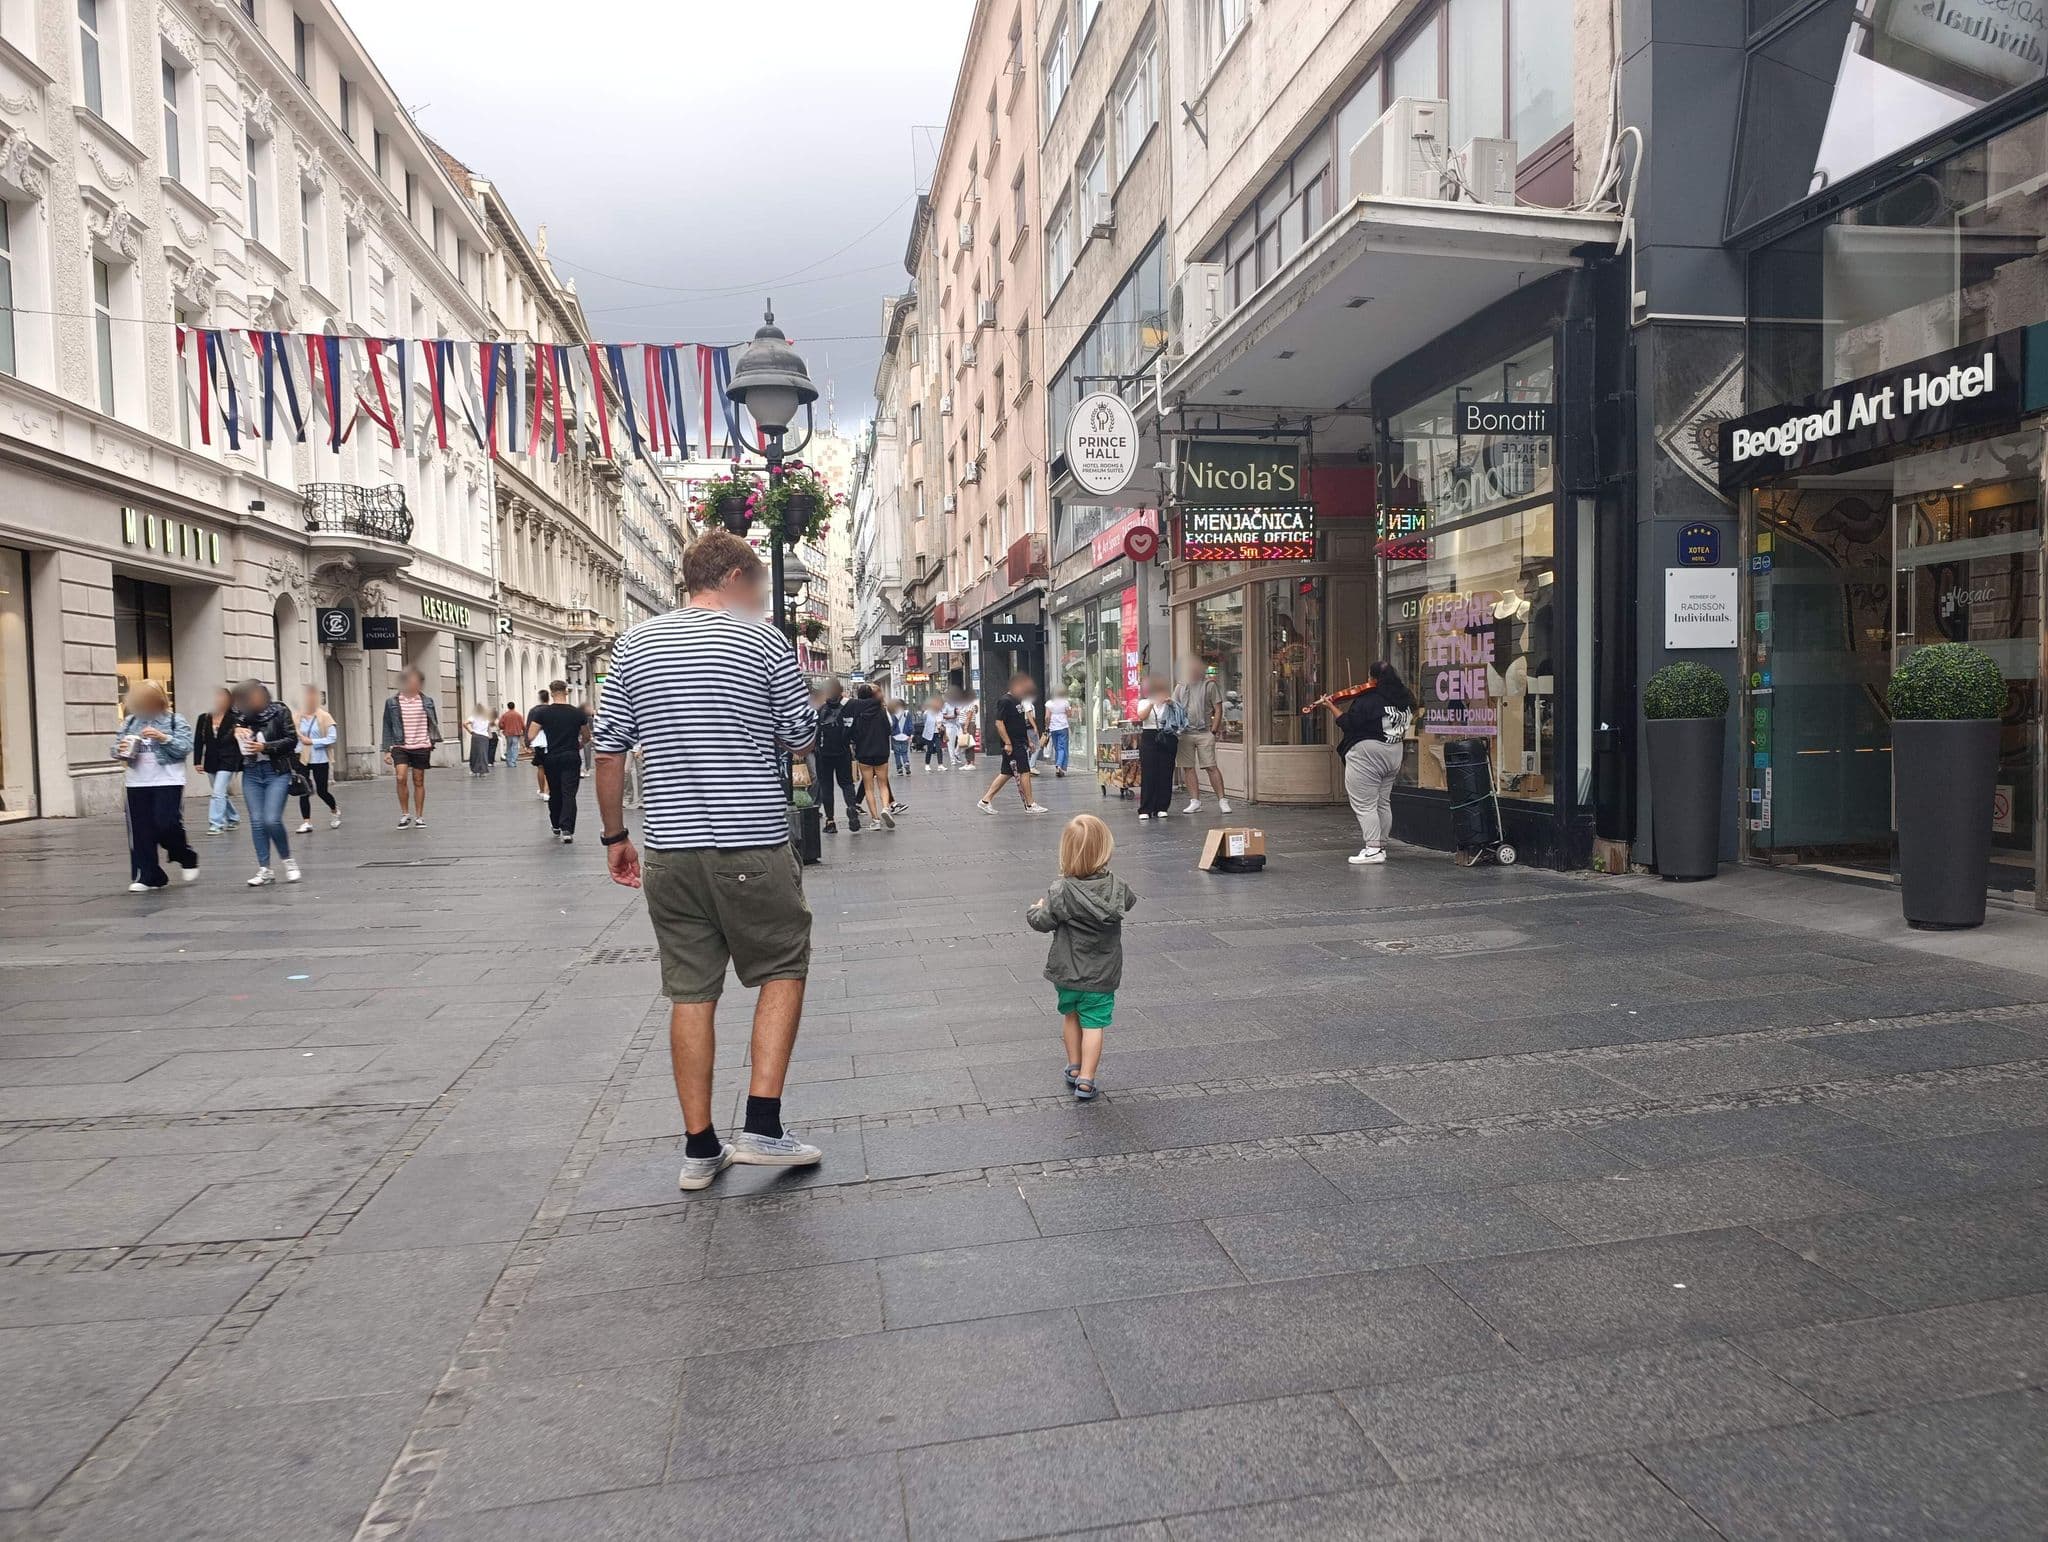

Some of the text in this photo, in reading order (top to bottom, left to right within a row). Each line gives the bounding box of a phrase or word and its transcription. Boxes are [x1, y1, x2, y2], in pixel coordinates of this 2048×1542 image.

[1732, 352, 1994, 462] Beograd Art Hotel
[1467, 405, 1545, 431] Bonatti
[1078, 436, 1127, 448] PRINCE
[1085, 448, 1120, 459] HALL
[1194, 508, 1304, 531] MENJAČNICA
[121, 506, 220, 564] MOHITO
[1186, 531, 1311, 544] EXCHANGE OFFICE
[1239, 546, 1258, 557] 5m
[421, 595, 471, 627] RESERVED
[1681, 603, 1725, 611] RADISSON
[496, 617, 512, 633] R
[1427, 631, 1495, 667] LETNJE
[1435, 668, 1485, 701] CENE
[1431, 708, 1455, 722] DALJE
[1456, 708, 1462, 721] U
[1463, 707, 1497, 722] PONUDI
